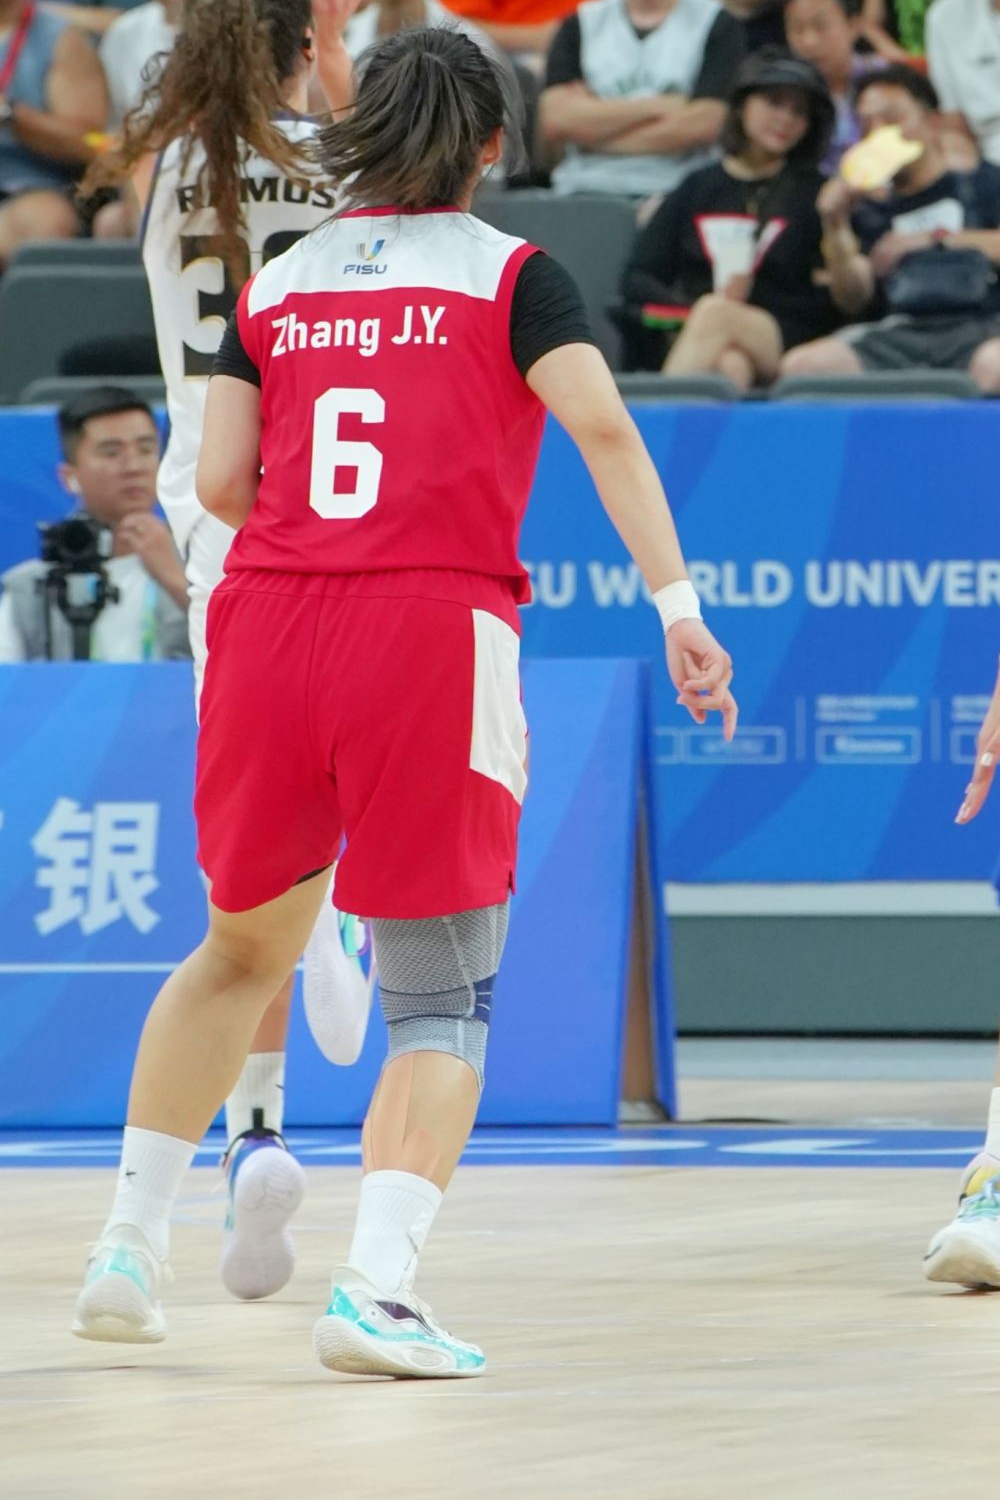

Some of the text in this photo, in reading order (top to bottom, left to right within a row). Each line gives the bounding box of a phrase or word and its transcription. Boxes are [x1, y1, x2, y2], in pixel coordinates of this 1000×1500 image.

[177, 176, 336, 213] RMOS
[343, 264, 388, 275] FISU
[271, 306, 448, 357] Zhang J.Y.
[309, 387, 386, 519] 6
[587, 560, 794, 607] WRLD
[0, 796, 161, 936] 银
